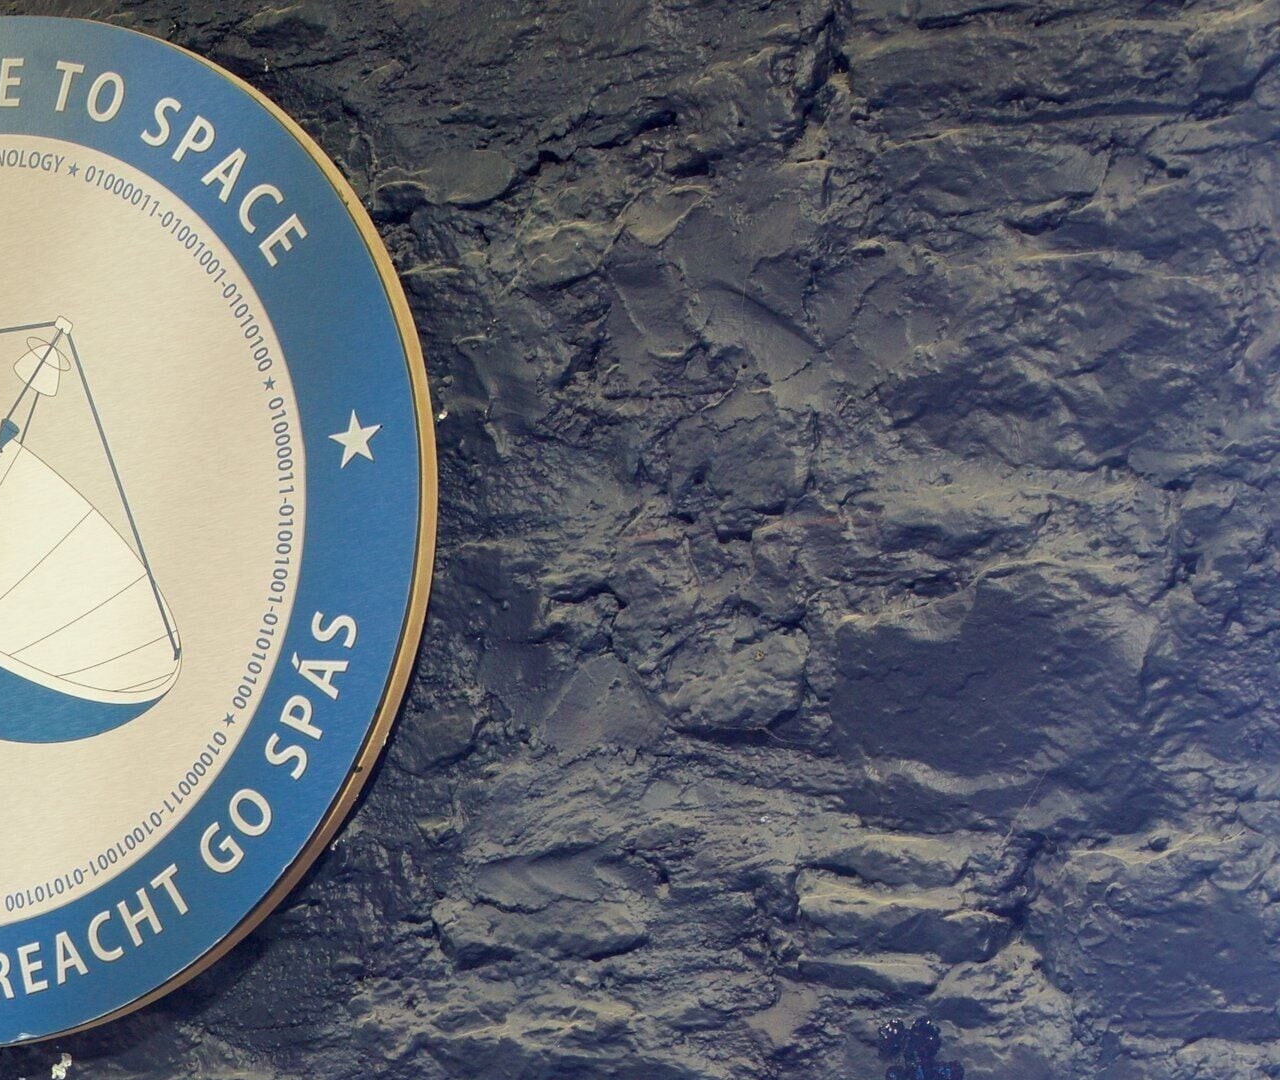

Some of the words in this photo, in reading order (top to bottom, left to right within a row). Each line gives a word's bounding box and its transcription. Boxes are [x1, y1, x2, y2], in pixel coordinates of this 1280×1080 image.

[55, 60, 124, 122] TO
[140, 97, 308, 267] SPACE
[200, 788, 272, 874] GO
[264, 611, 358, 780] SPÁS
